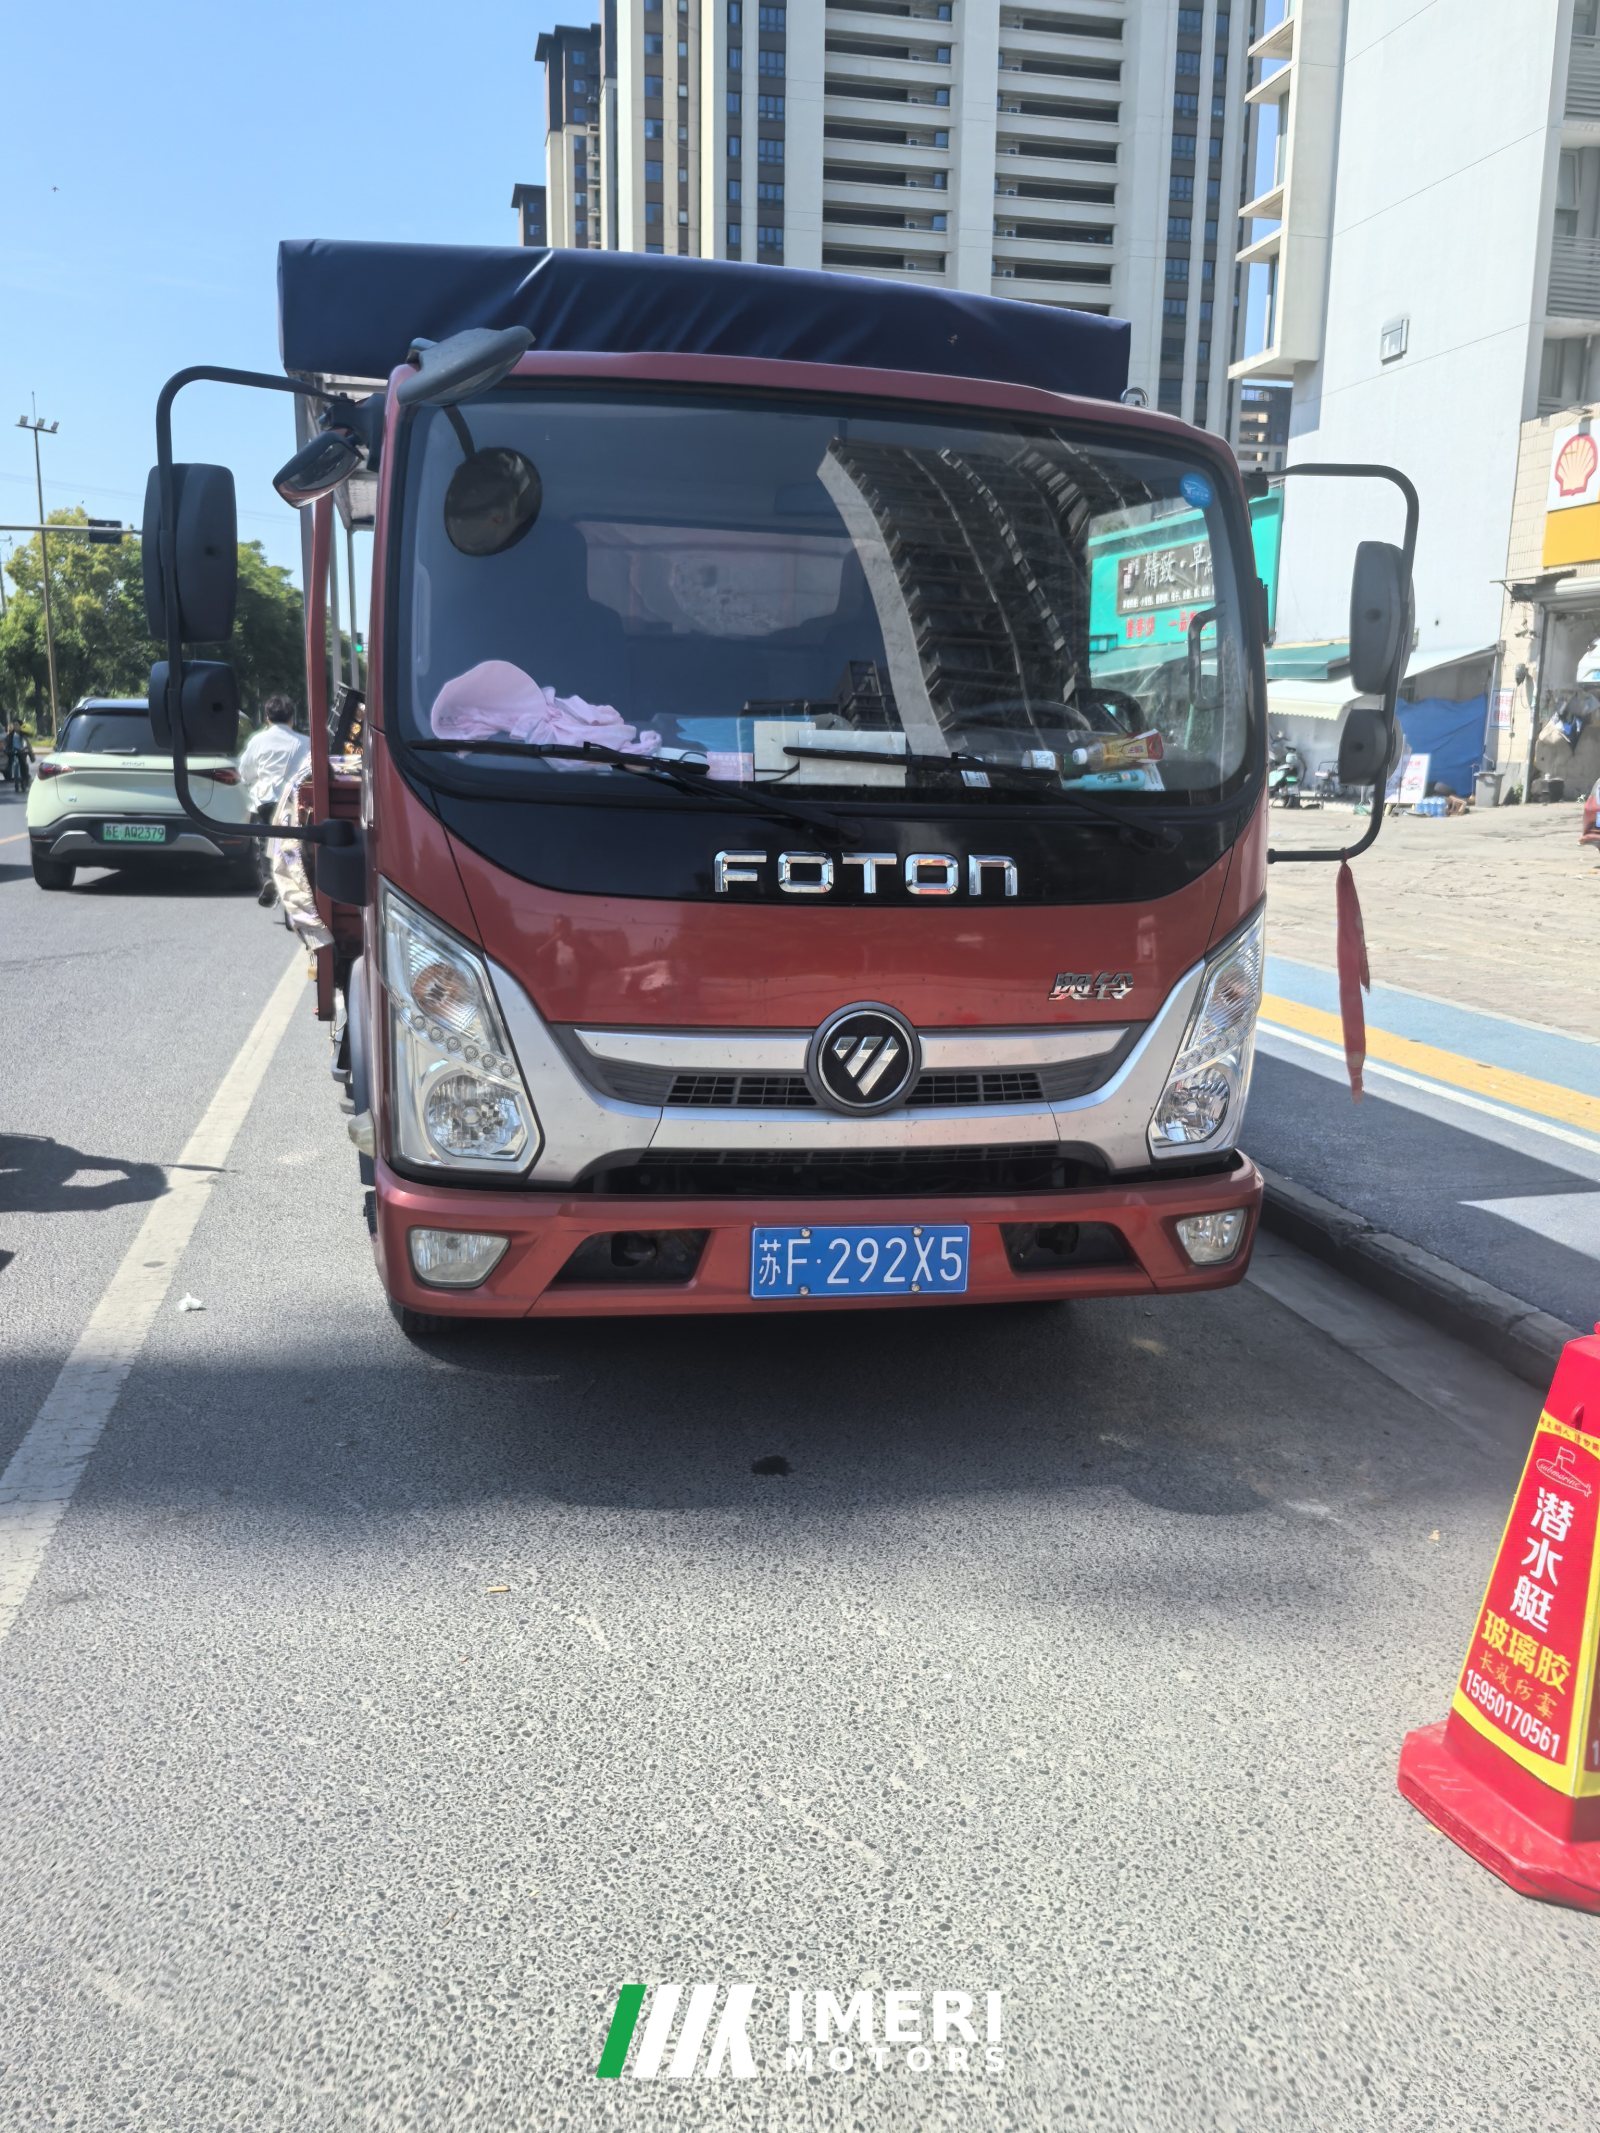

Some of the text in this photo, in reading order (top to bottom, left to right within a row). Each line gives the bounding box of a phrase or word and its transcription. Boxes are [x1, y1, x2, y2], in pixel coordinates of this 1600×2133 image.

[714, 850, 1018, 896] FOTON
[1509, 1486, 1576, 1634] 潜水艇
[1481, 1608, 1572, 1696] 玻璃胶
[1465, 1668, 1561, 1759] 15950170561
